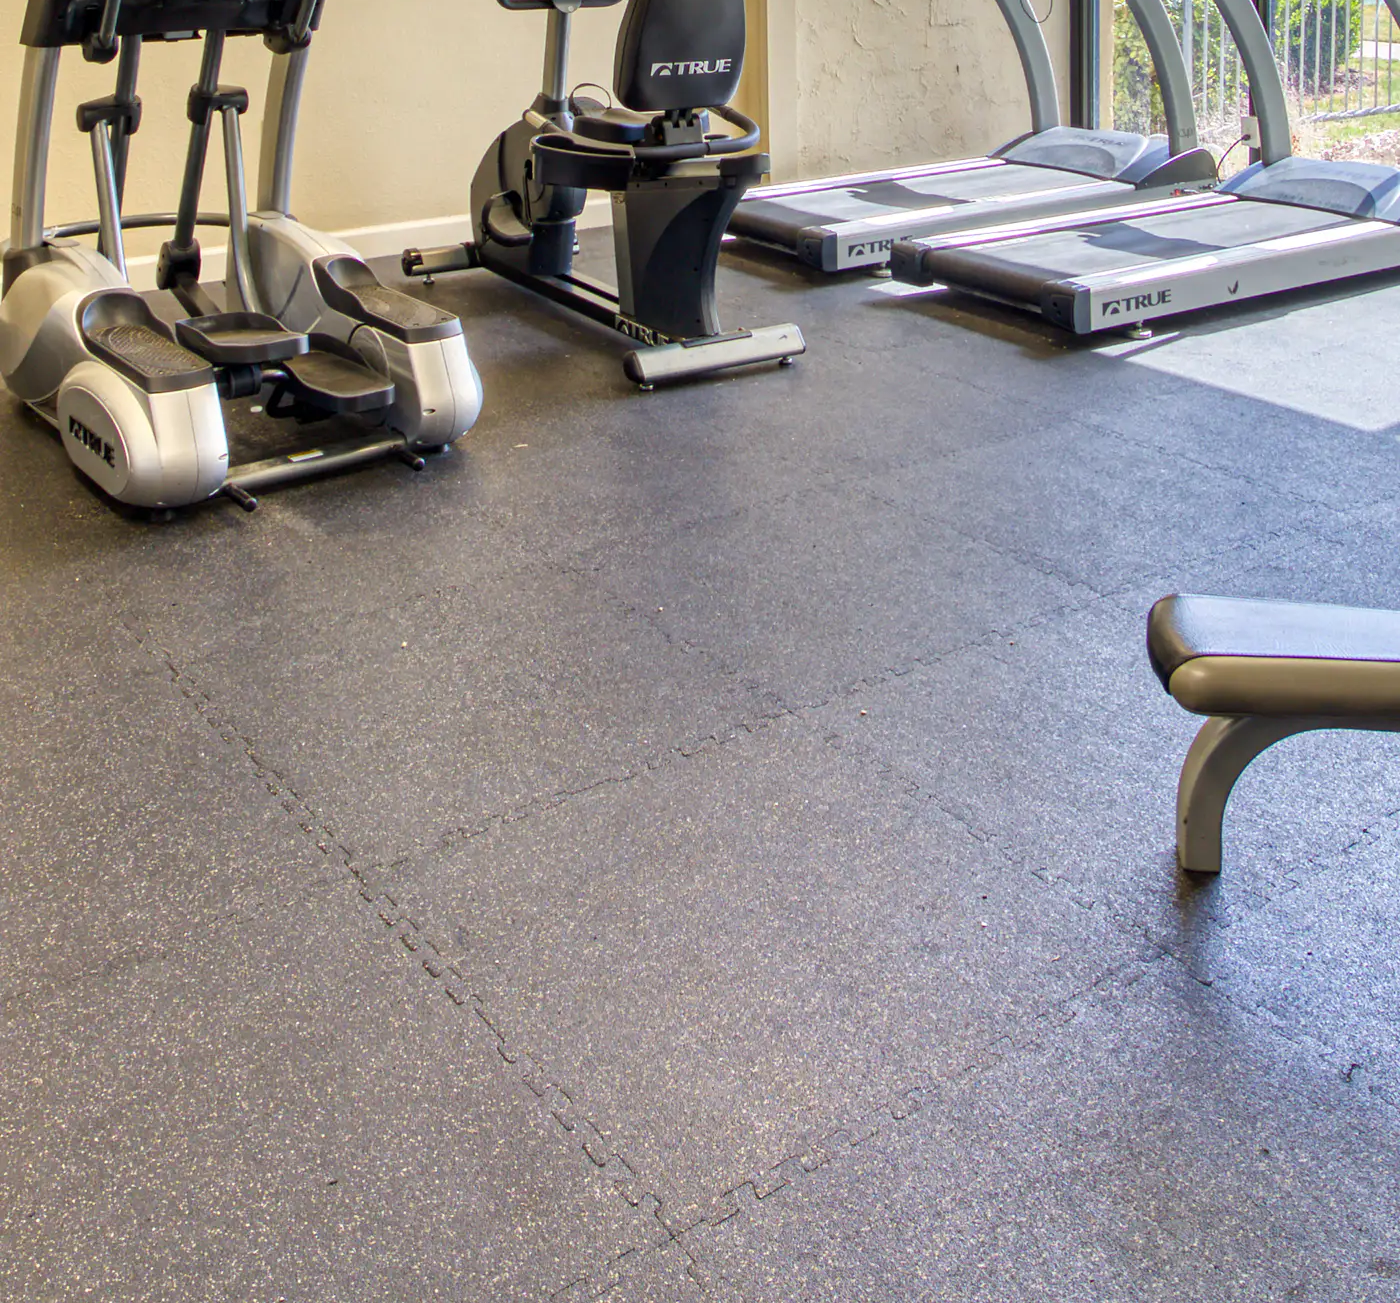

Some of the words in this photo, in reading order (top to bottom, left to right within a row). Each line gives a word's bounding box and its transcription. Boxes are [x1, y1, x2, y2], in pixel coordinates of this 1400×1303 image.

[674, 59, 732, 75] TRUE
[1121, 289, 1172, 312] TRUE
[82, 424, 115, 469] TRUE
